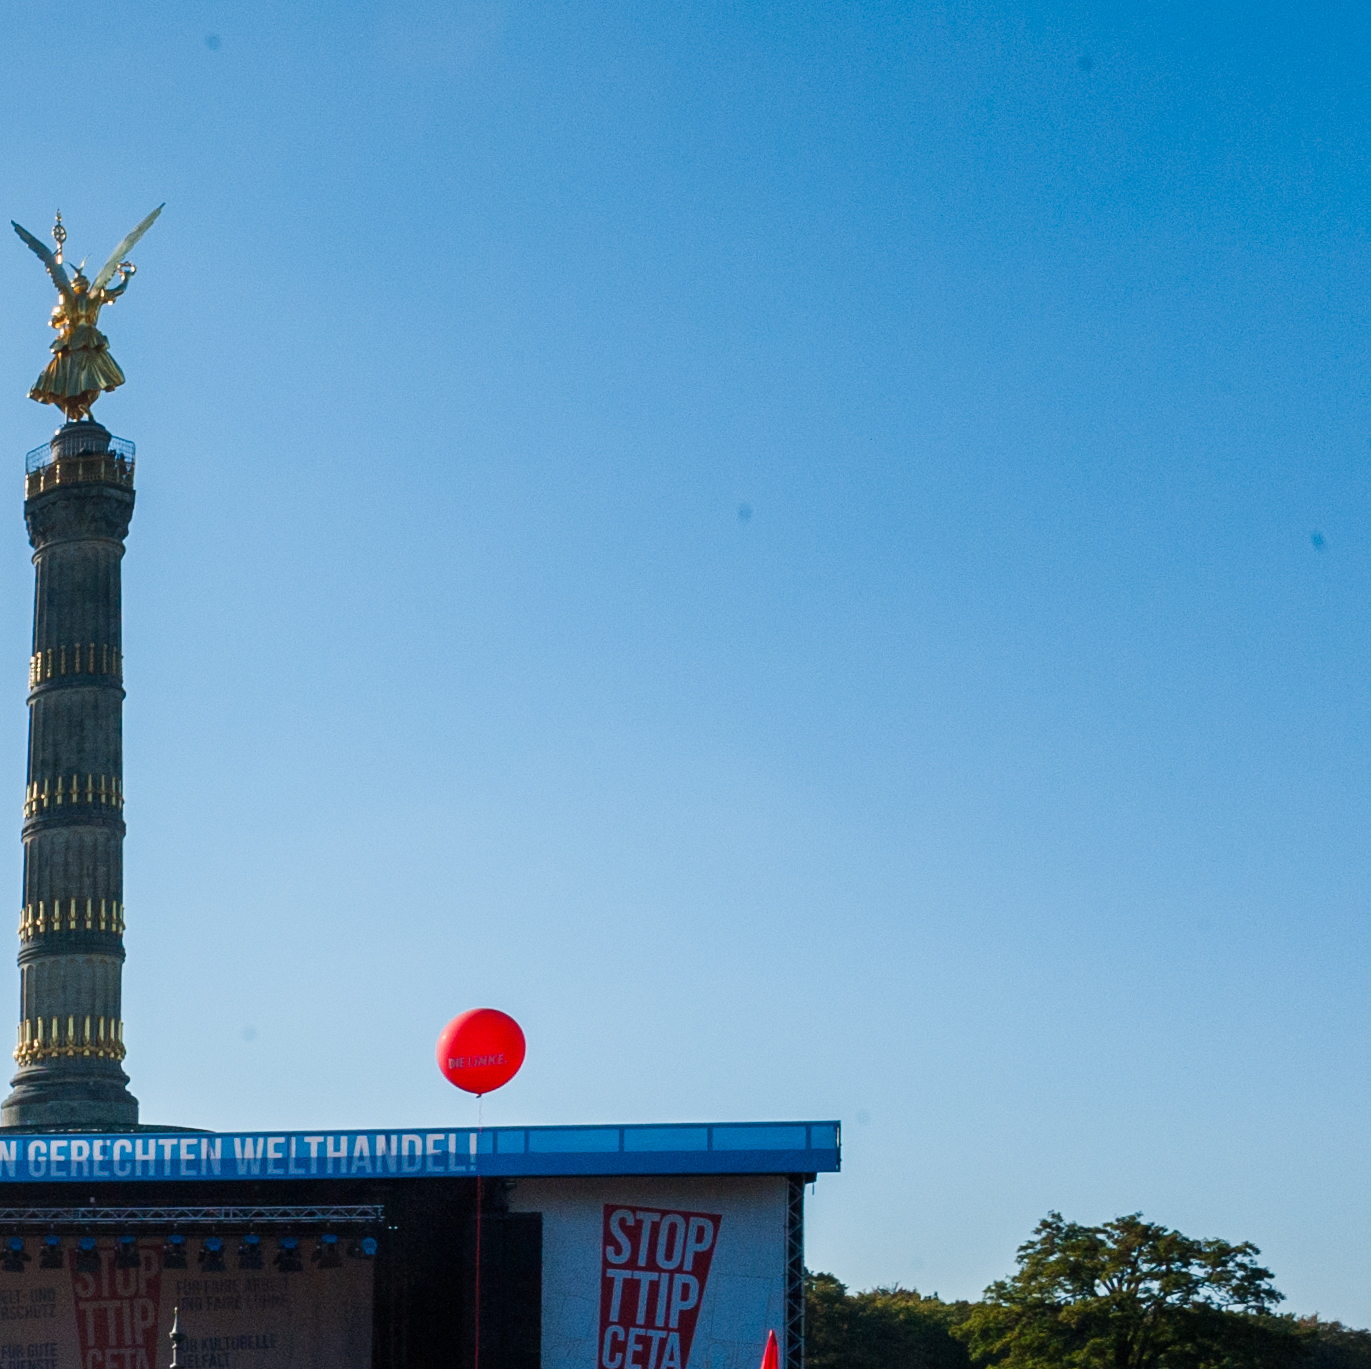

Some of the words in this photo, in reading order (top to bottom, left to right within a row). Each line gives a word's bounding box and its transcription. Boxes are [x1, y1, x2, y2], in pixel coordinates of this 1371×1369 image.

[27, 1136, 222, 1177] GERECHTEN
[234, 1132, 479, 1176] WELTHANDEL!
[606, 1209, 715, 1272] STOP
[78, 1299, 155, 1347] TTIP
[606, 1270, 700, 1329] TTIP
